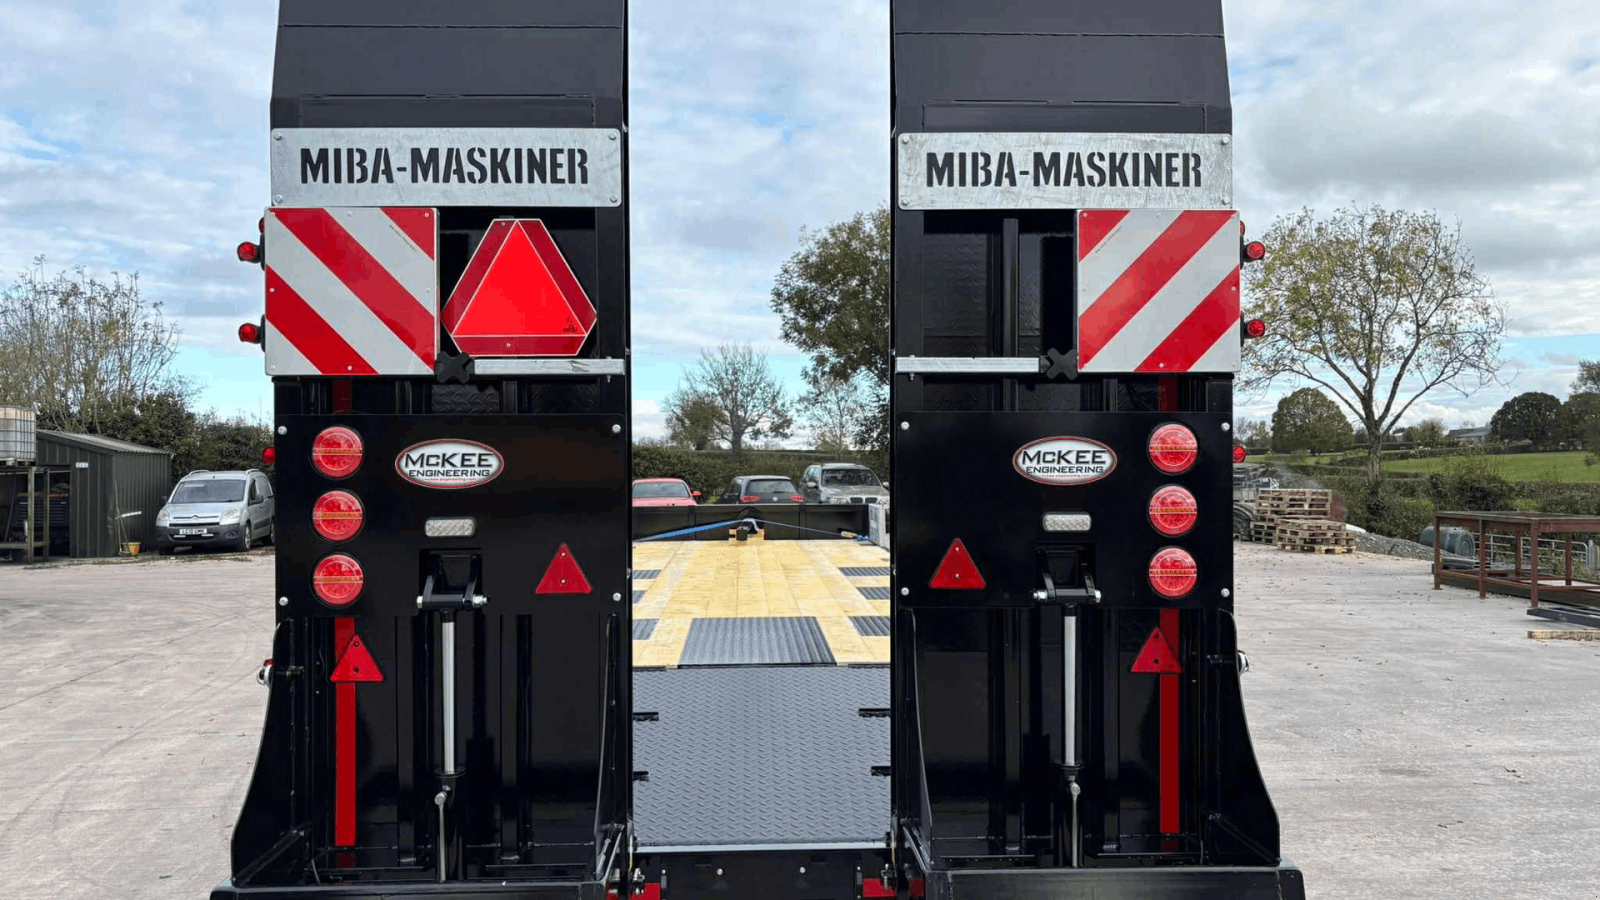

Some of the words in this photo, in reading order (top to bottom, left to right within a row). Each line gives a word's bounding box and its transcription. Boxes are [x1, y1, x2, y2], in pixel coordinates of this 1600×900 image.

[300, 147, 589, 185] MIBA-MASKINER
[926, 151, 1202, 188] MIBA-MASKINER
[408, 469, 490, 477] ENGINEERING
[1025, 465, 1104, 474] ENGINEERING
